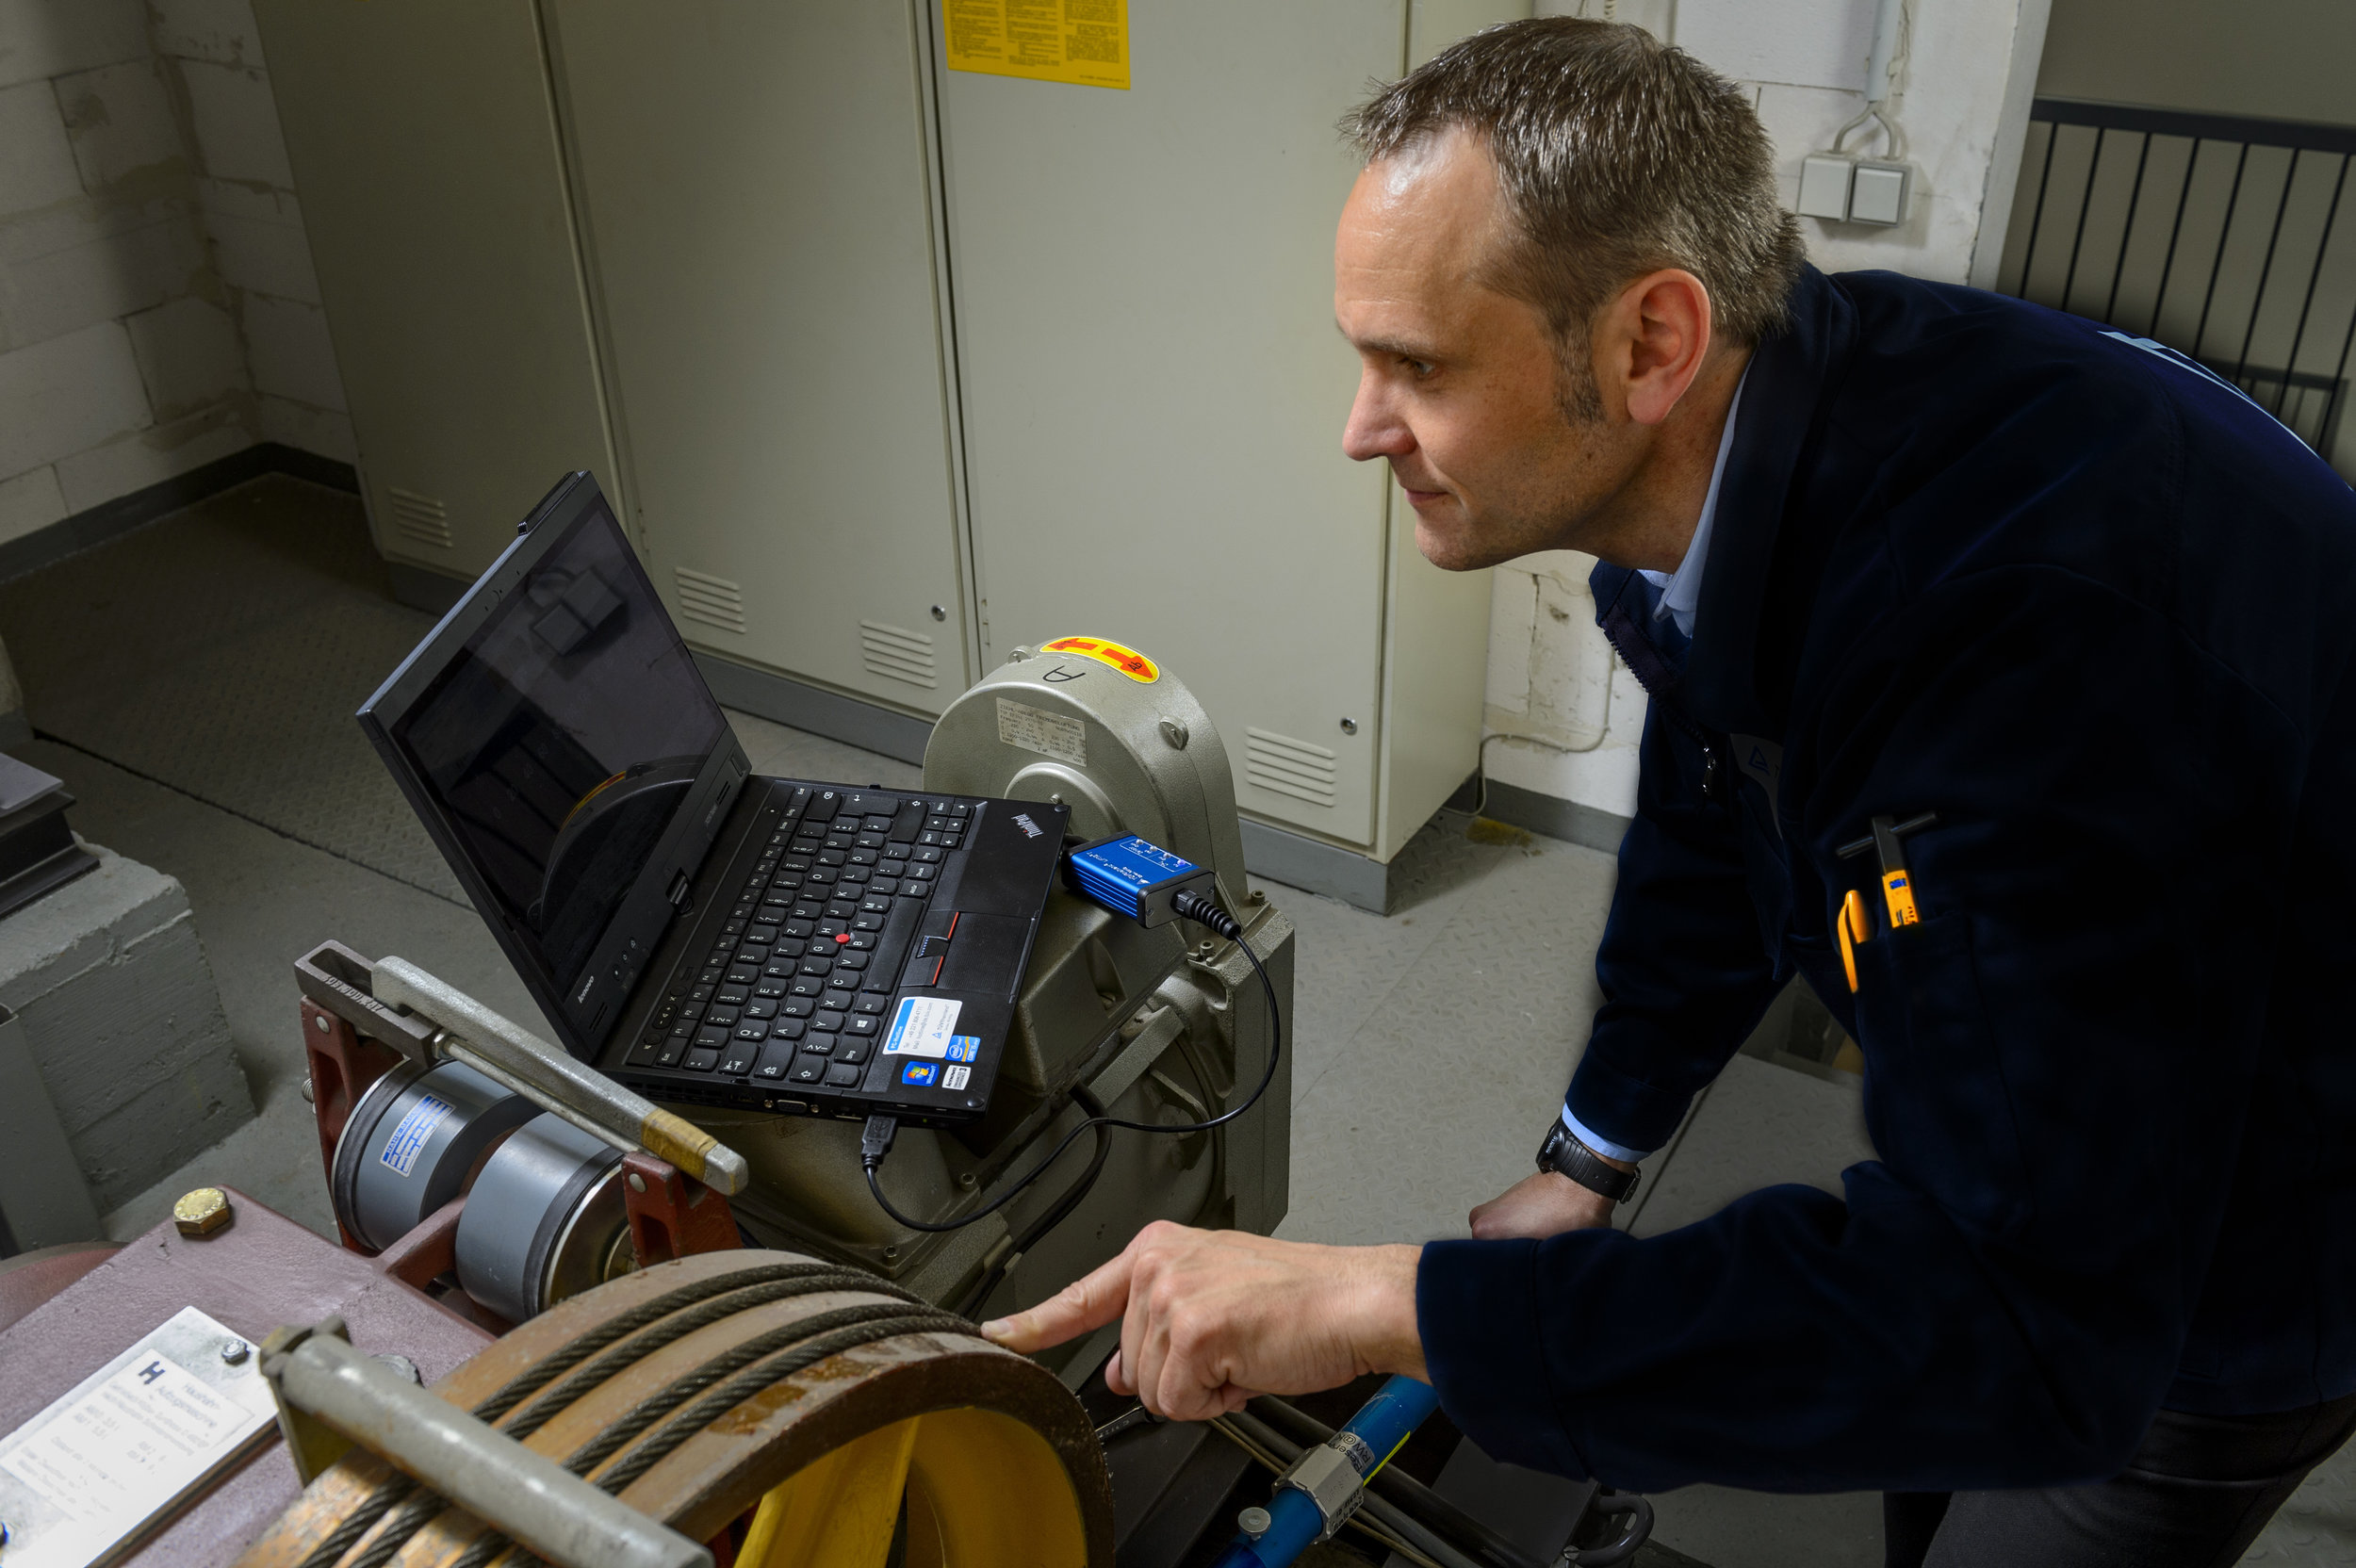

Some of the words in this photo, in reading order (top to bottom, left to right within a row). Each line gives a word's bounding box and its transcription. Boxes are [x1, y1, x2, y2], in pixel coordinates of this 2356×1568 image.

[1128, 662, 1142, 672] Ab
[578, 975, 595, 1004] lenovo
[846, 1051, 856, 1059] Strg
